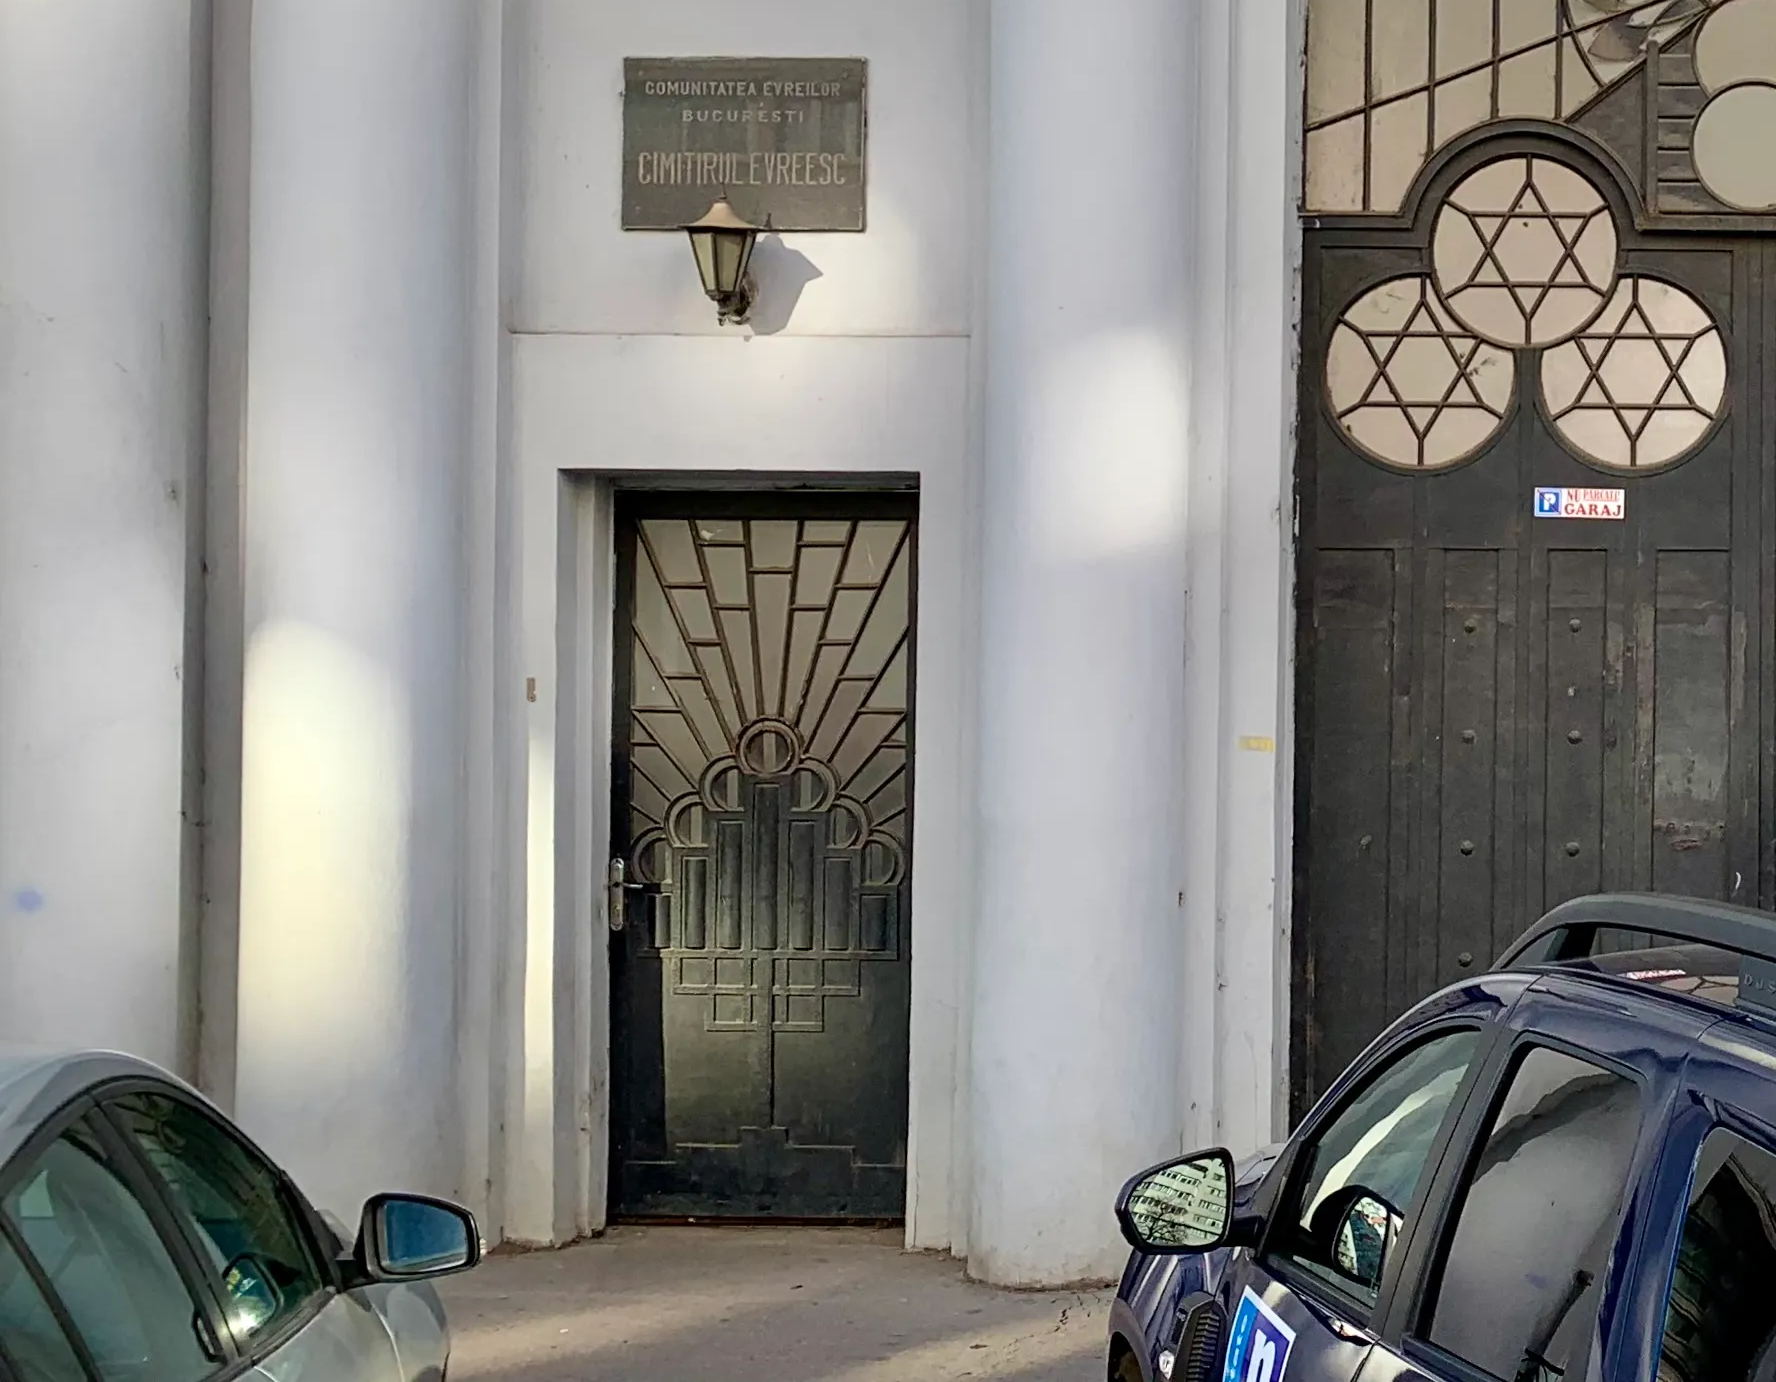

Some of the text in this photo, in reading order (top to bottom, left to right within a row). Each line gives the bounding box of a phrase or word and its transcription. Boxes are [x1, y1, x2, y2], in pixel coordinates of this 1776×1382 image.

[644, 81, 840, 97] COMUNITATEA EVREILOR
[638, 151, 845, 185] CIMITIRUL EVREESC
[1567, 489, 1580, 502] NU
[1564, 503, 1622, 516] GARAJ
